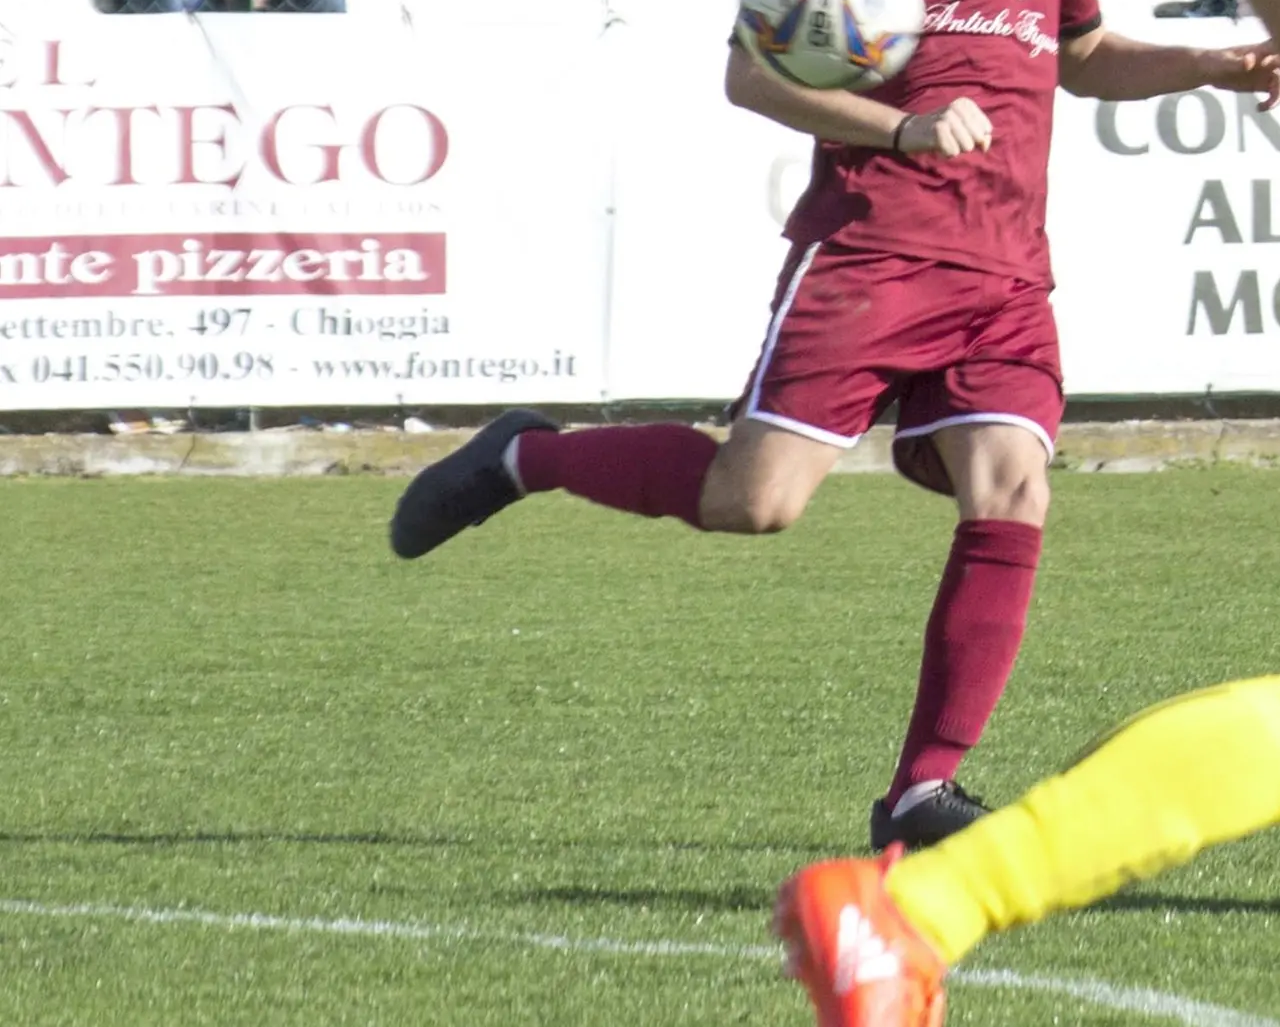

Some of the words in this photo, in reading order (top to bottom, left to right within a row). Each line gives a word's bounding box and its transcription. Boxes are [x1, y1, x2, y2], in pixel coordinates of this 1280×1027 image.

[131, 239, 430, 295] pizzeria
[188, 308, 253, 337] 497
[290, 307, 450, 341] Chioggia
[311, 348, 577, 383] www.fontego.it
